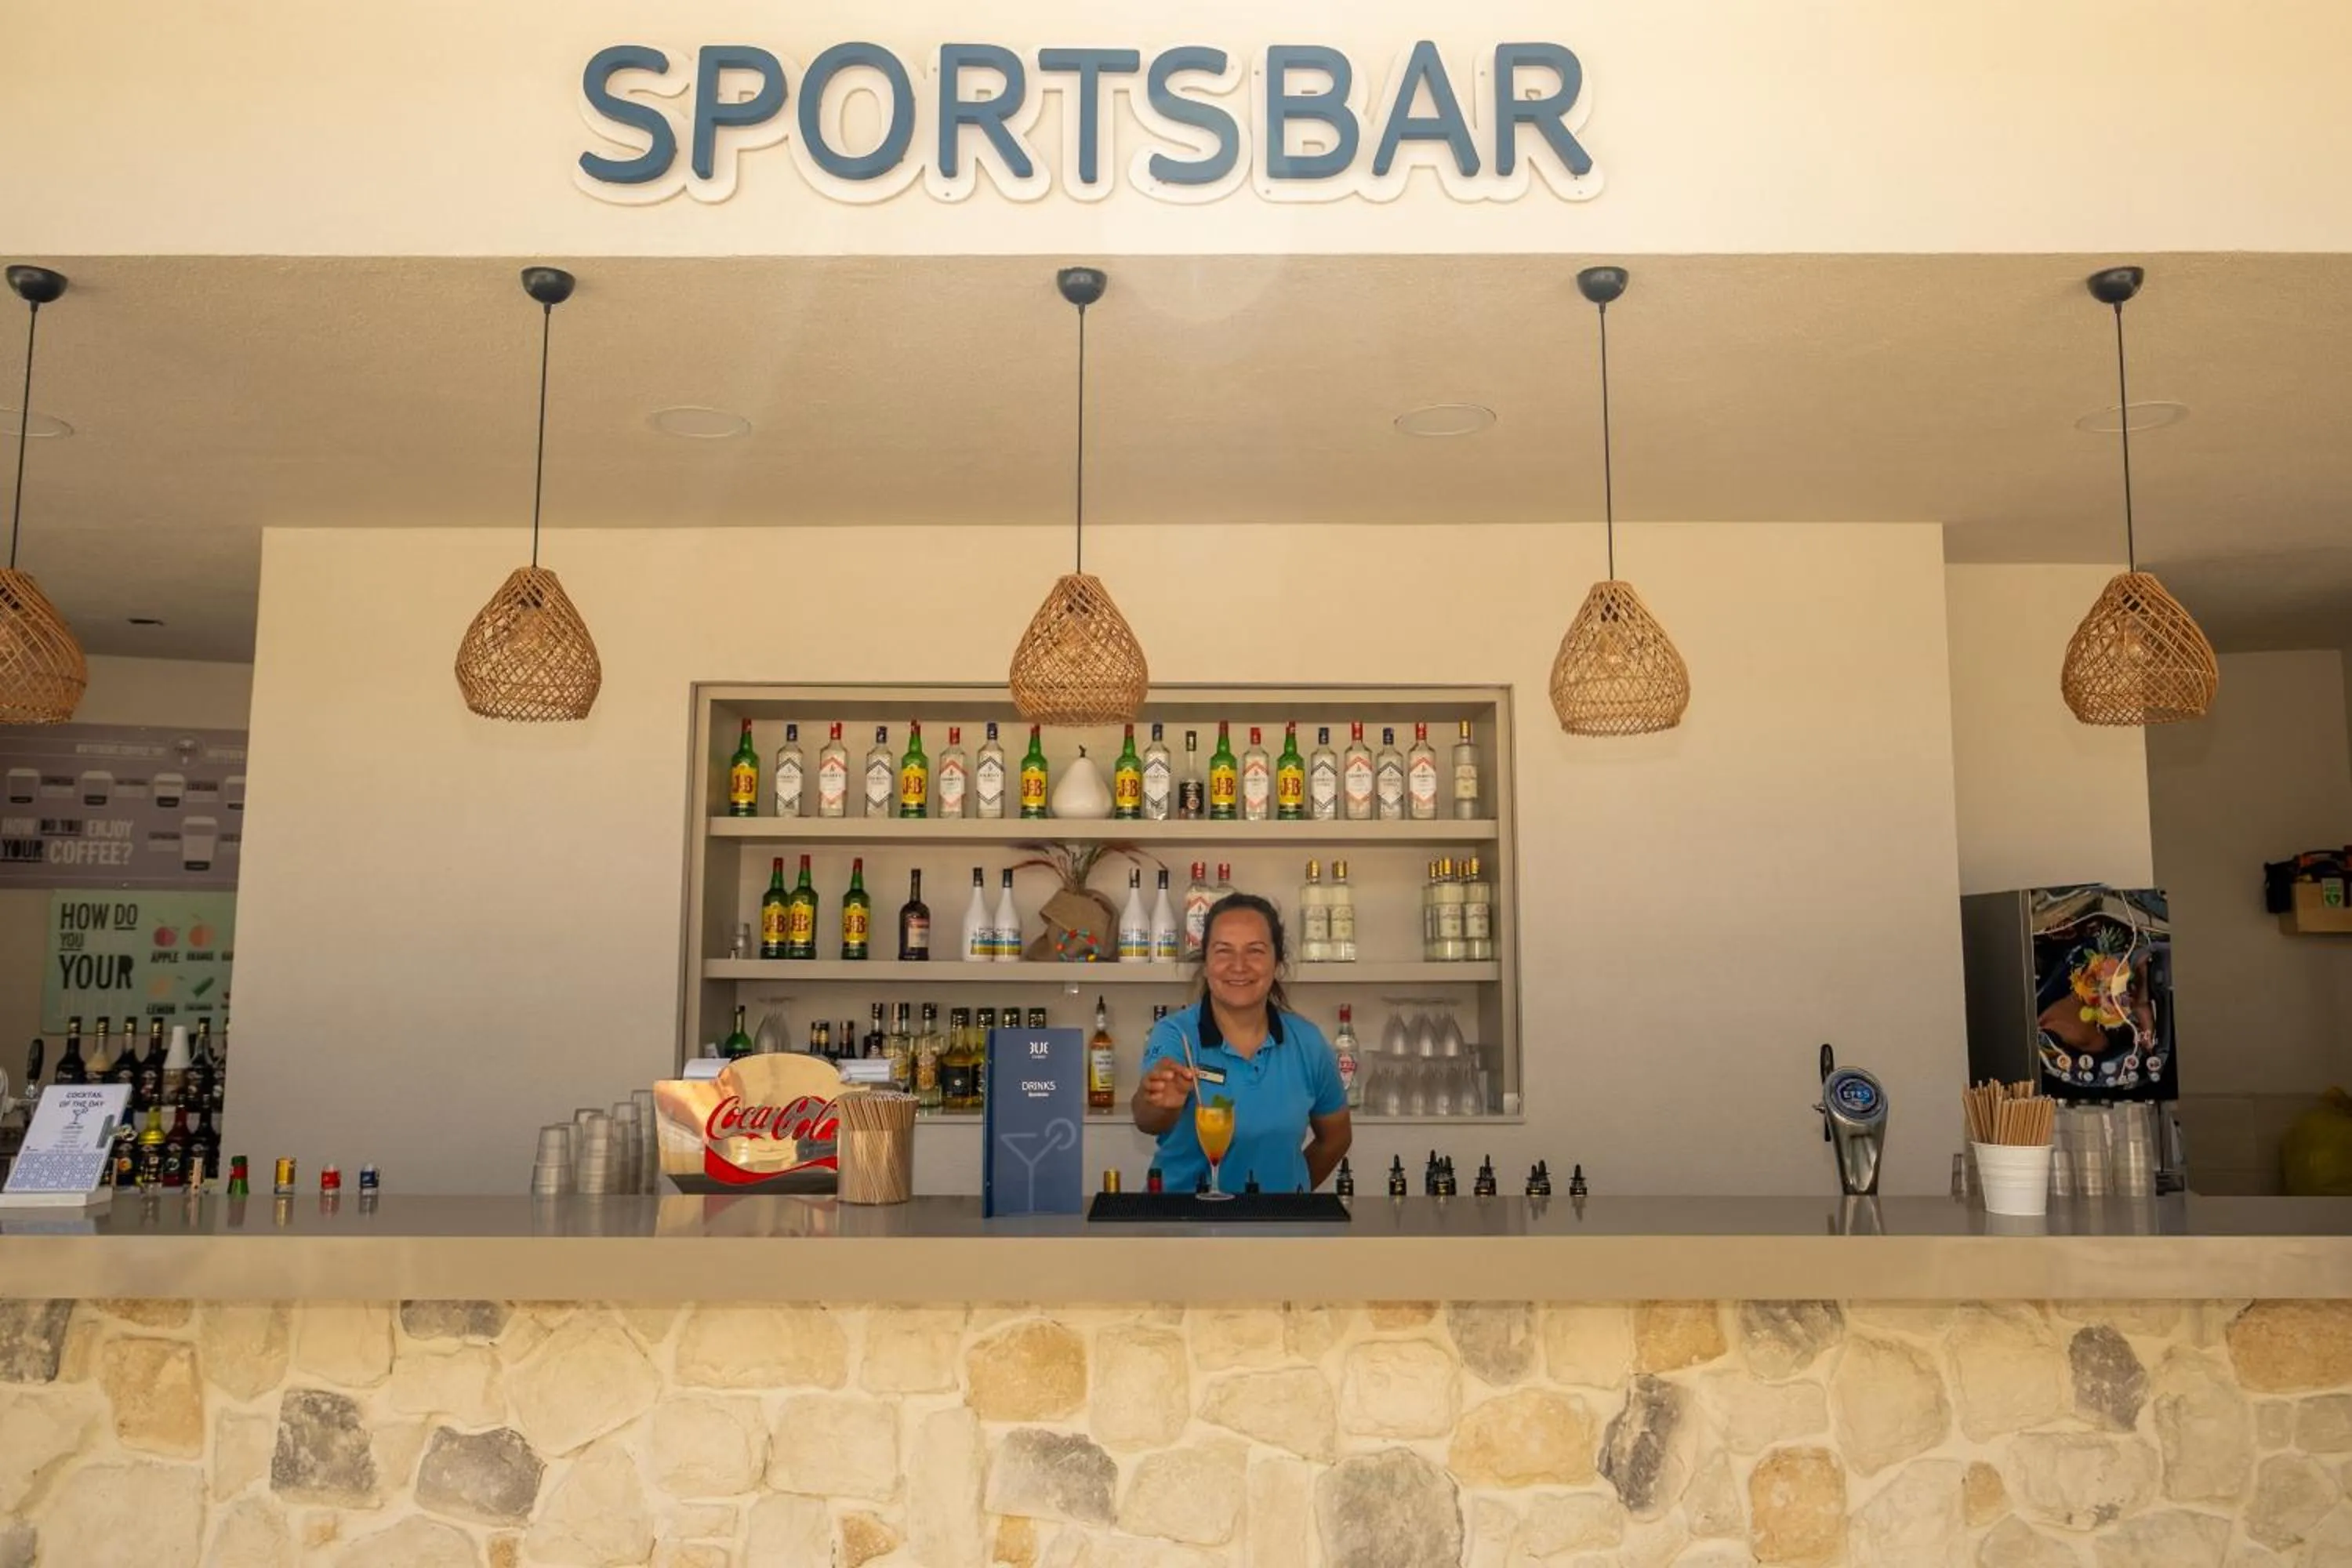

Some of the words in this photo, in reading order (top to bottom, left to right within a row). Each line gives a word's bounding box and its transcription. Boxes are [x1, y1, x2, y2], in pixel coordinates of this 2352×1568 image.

[579, 40, 1594, 184] SPORTSBAR
[87, 819, 134, 837] ENJOY
[2, 839, 43, 858] YOUR
[49, 840, 133, 865] COFFEE?
[60, 902, 110, 931] HOW
[114, 903, 138, 927] DO
[60, 932, 84, 949] YOU
[151, 951, 179, 964] APPLE
[58, 954, 134, 989] YOUR
[1022, 1081, 1056, 1091] DRINKS
